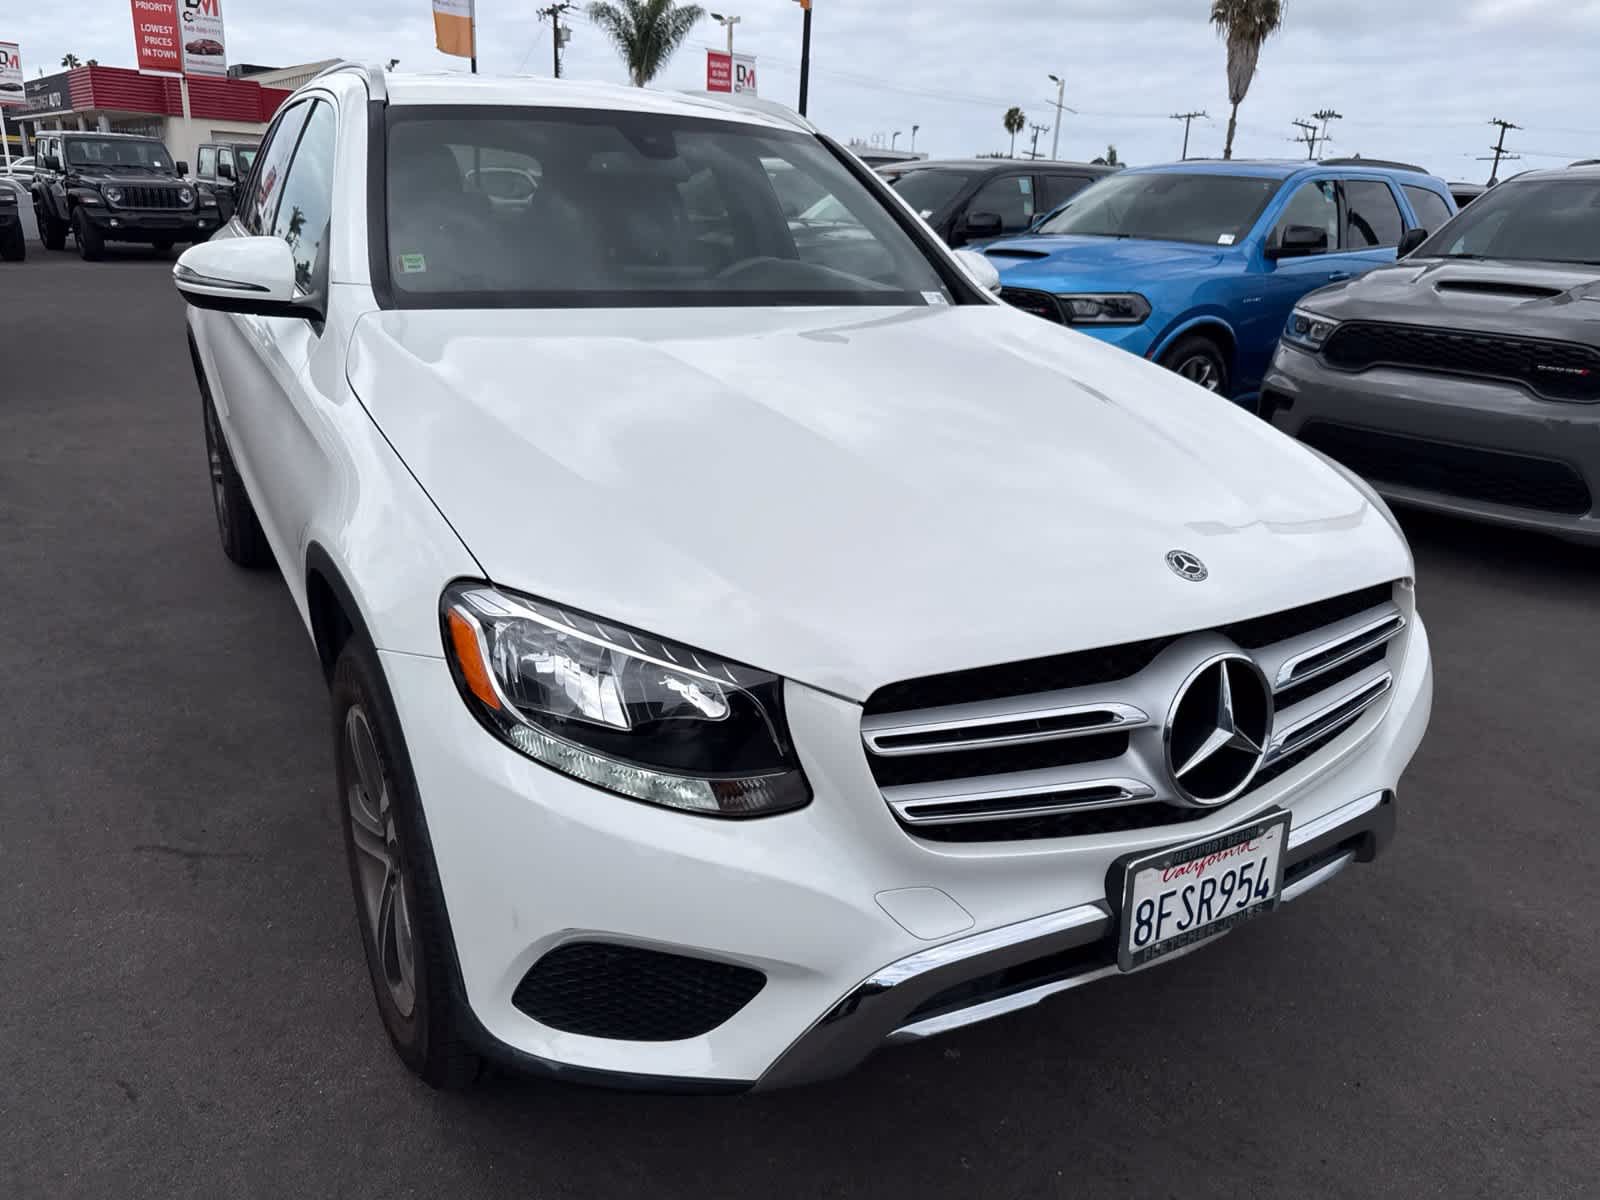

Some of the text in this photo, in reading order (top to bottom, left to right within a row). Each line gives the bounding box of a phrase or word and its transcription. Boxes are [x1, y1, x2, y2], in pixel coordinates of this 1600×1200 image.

[135, 1, 173, 12] PRIORITY
[140, 23, 173, 34] LOWEST
[144, 35, 173, 47] PRICES
[142, 47, 177, 59] IN TOWN
[1162, 840, 1260, 883] California
[1133, 856, 1270, 947] 8FSR954
